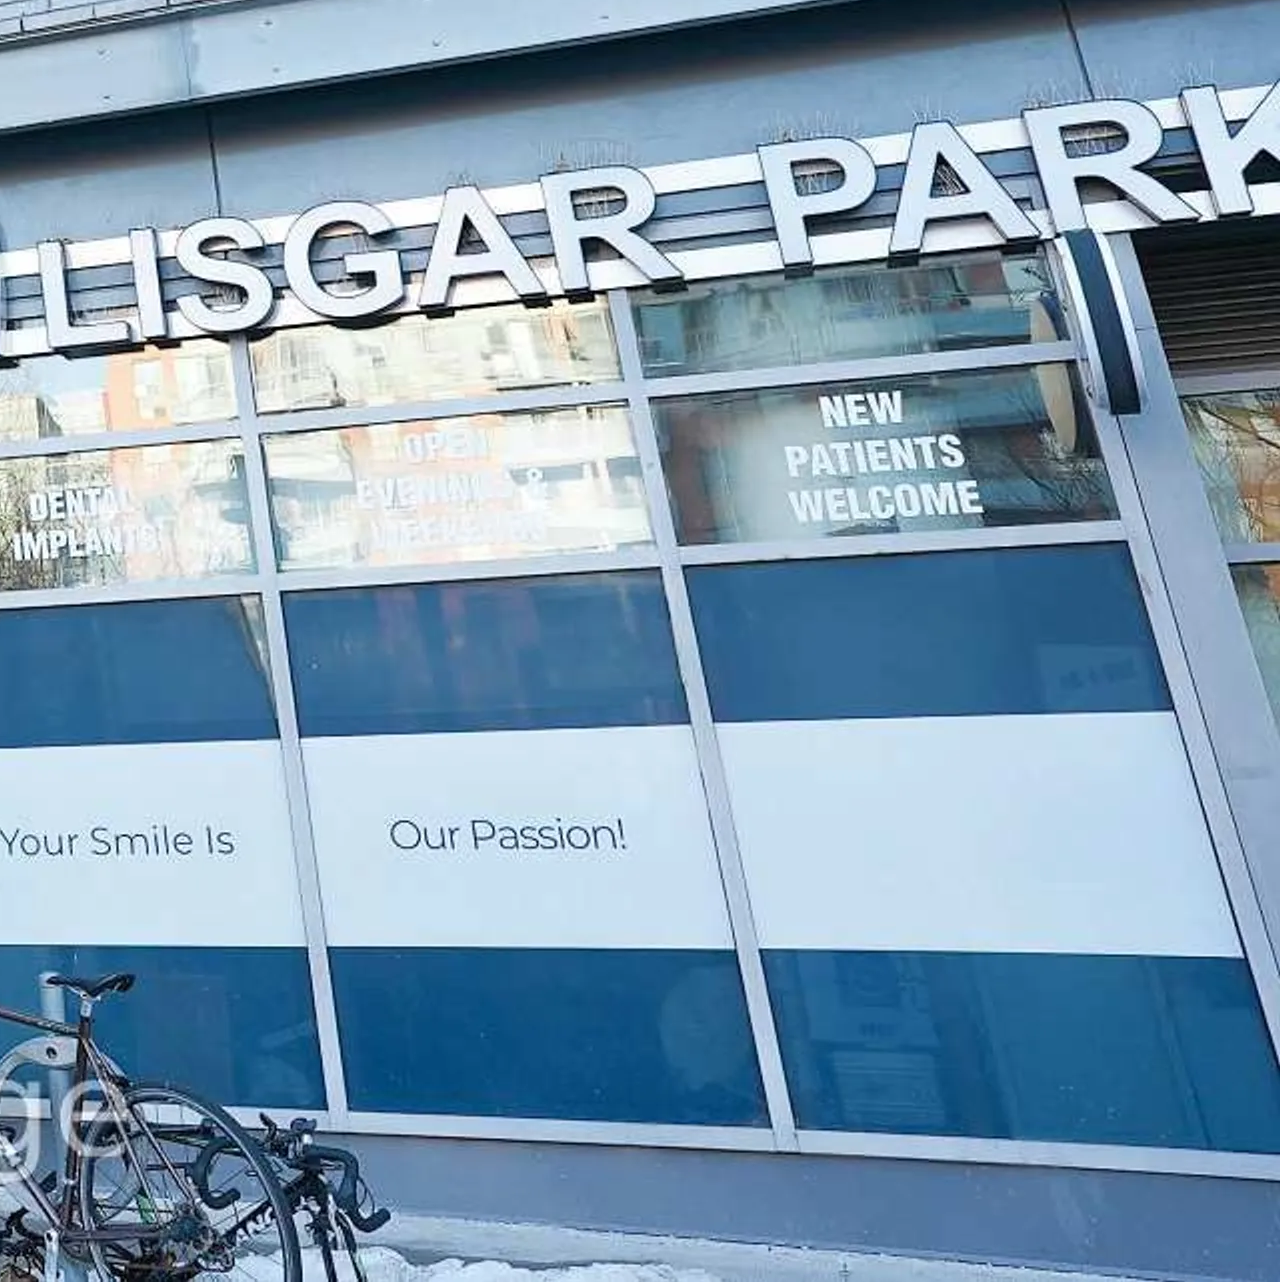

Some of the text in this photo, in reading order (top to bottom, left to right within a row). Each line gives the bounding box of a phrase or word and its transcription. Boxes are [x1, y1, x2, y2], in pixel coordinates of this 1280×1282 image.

[38, 78, 1280, 352] LISGAR PARK
[818, 391, 903, 428] NEW
[784, 433, 965, 478] PATIENTS
[29, 486, 138, 522] DENTAL
[787, 480, 984, 523] WELCOME
[11, 522, 159, 562] IMPLANTS
[90, 824, 193, 856] Smile
[205, 824, 236, 855] Is
[389, 817, 628, 850] Our Passion!
